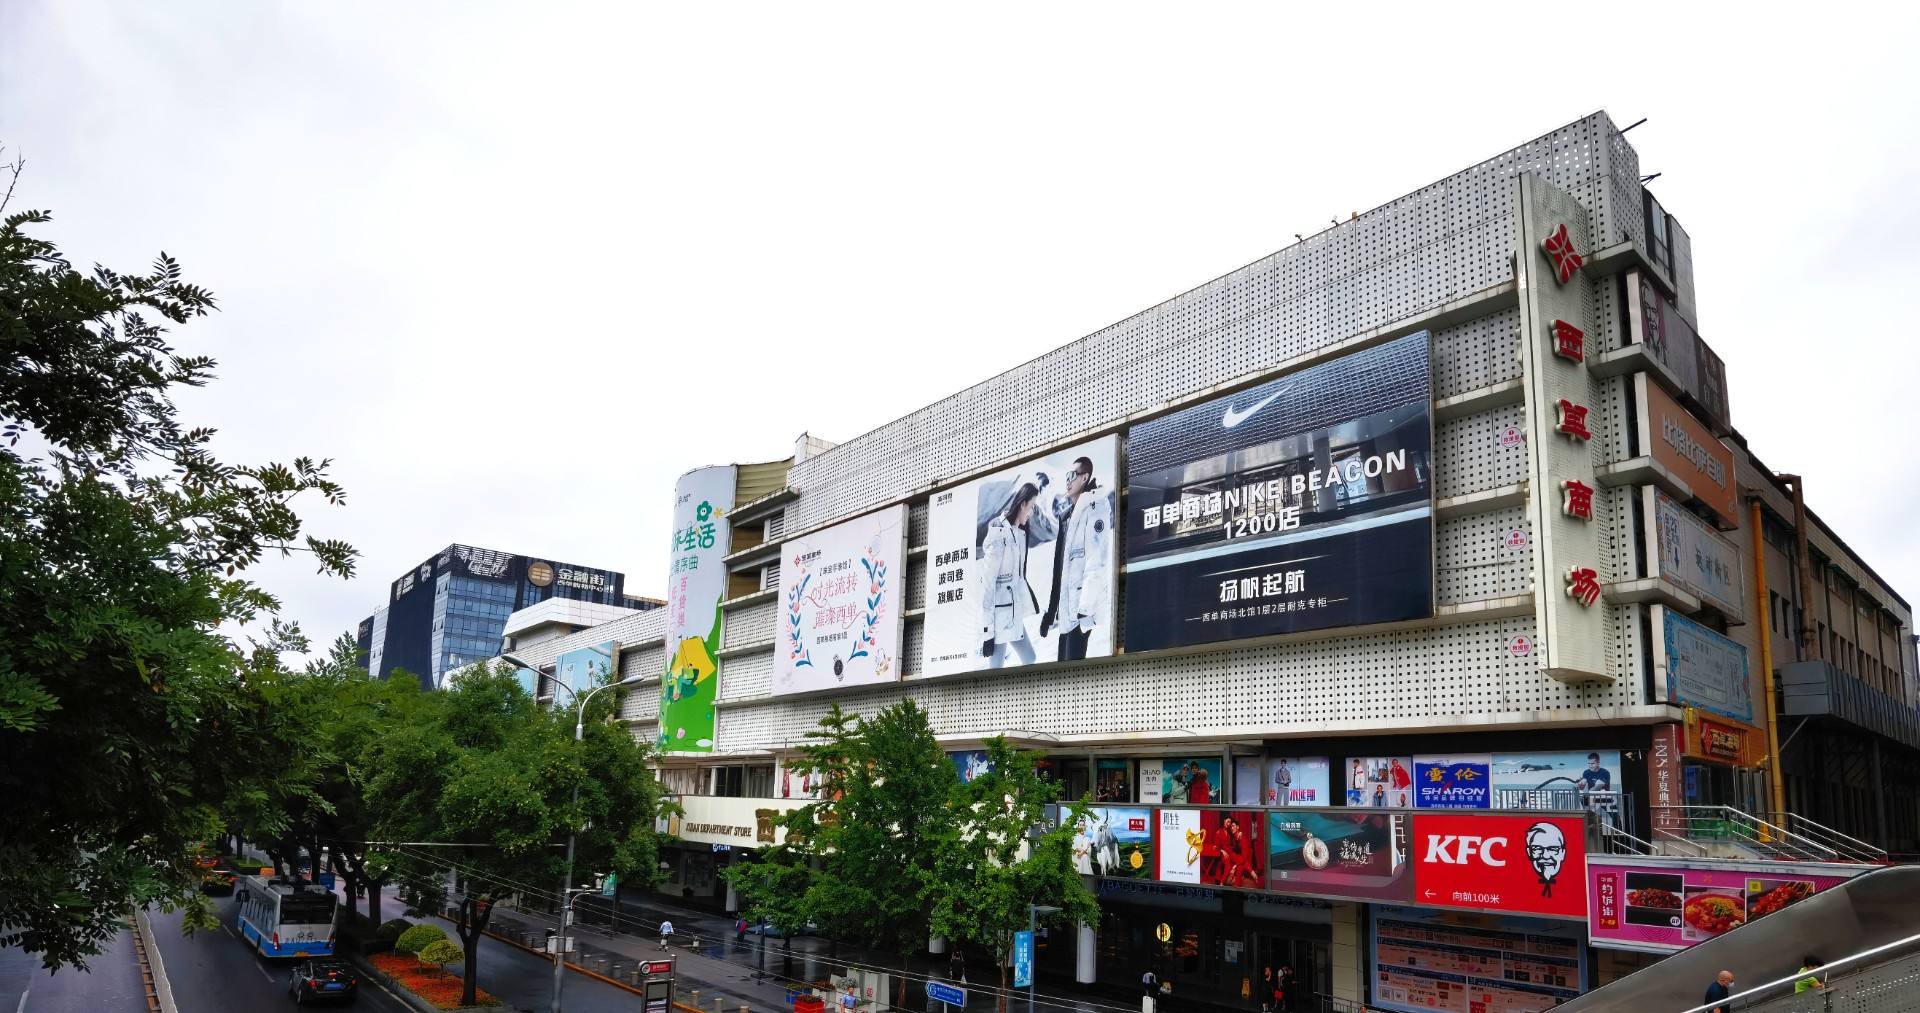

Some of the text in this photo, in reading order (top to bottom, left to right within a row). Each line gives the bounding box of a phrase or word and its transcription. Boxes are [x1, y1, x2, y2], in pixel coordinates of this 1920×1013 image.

[1290, 448, 1407, 497] BEACON
[1223, 506, 1301, 540] 1200店
[935, 547, 969, 568] 西单商场
[557, 568, 605, 586] 金融街
[938, 568, 964, 586] 波司登
[1219, 568, 1306, 602] 扬帆起航
[937, 587, 964, 605] 旗舰店
[1421, 786, 1486, 796] SHARON
[700, 823, 733, 836] DEPARTMENT
[733, 826, 752, 837] STORE
[1424, 834, 1508, 867] KFC
[1452, 890, 1500, 905] 向前100米
